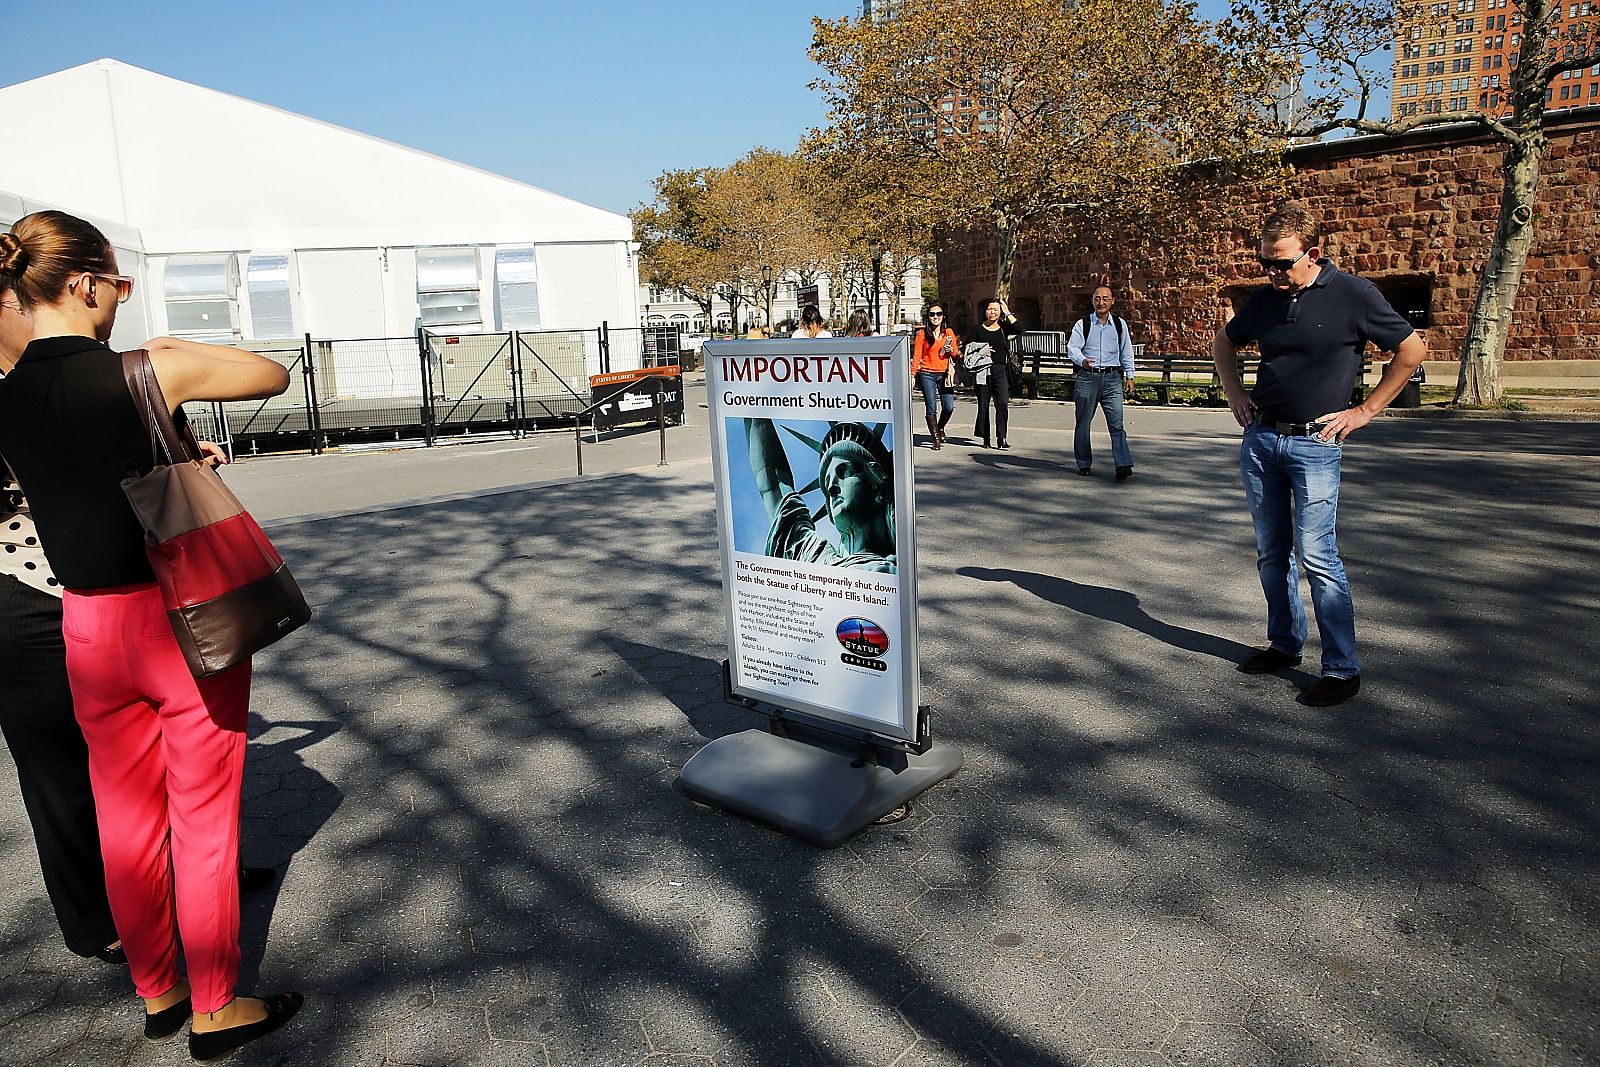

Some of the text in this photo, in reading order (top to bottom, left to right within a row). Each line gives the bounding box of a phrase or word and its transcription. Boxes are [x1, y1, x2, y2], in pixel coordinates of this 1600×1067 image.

[722, 356, 891, 383] IMPORTANT
[724, 391, 892, 410] Government Shut-Down
[736, 560, 896, 594] The Government has temporarily shut down
[736, 572, 889, 606] both the Statue of Liberty and Ellis Island.
[846, 640, 880, 654] STATUE
